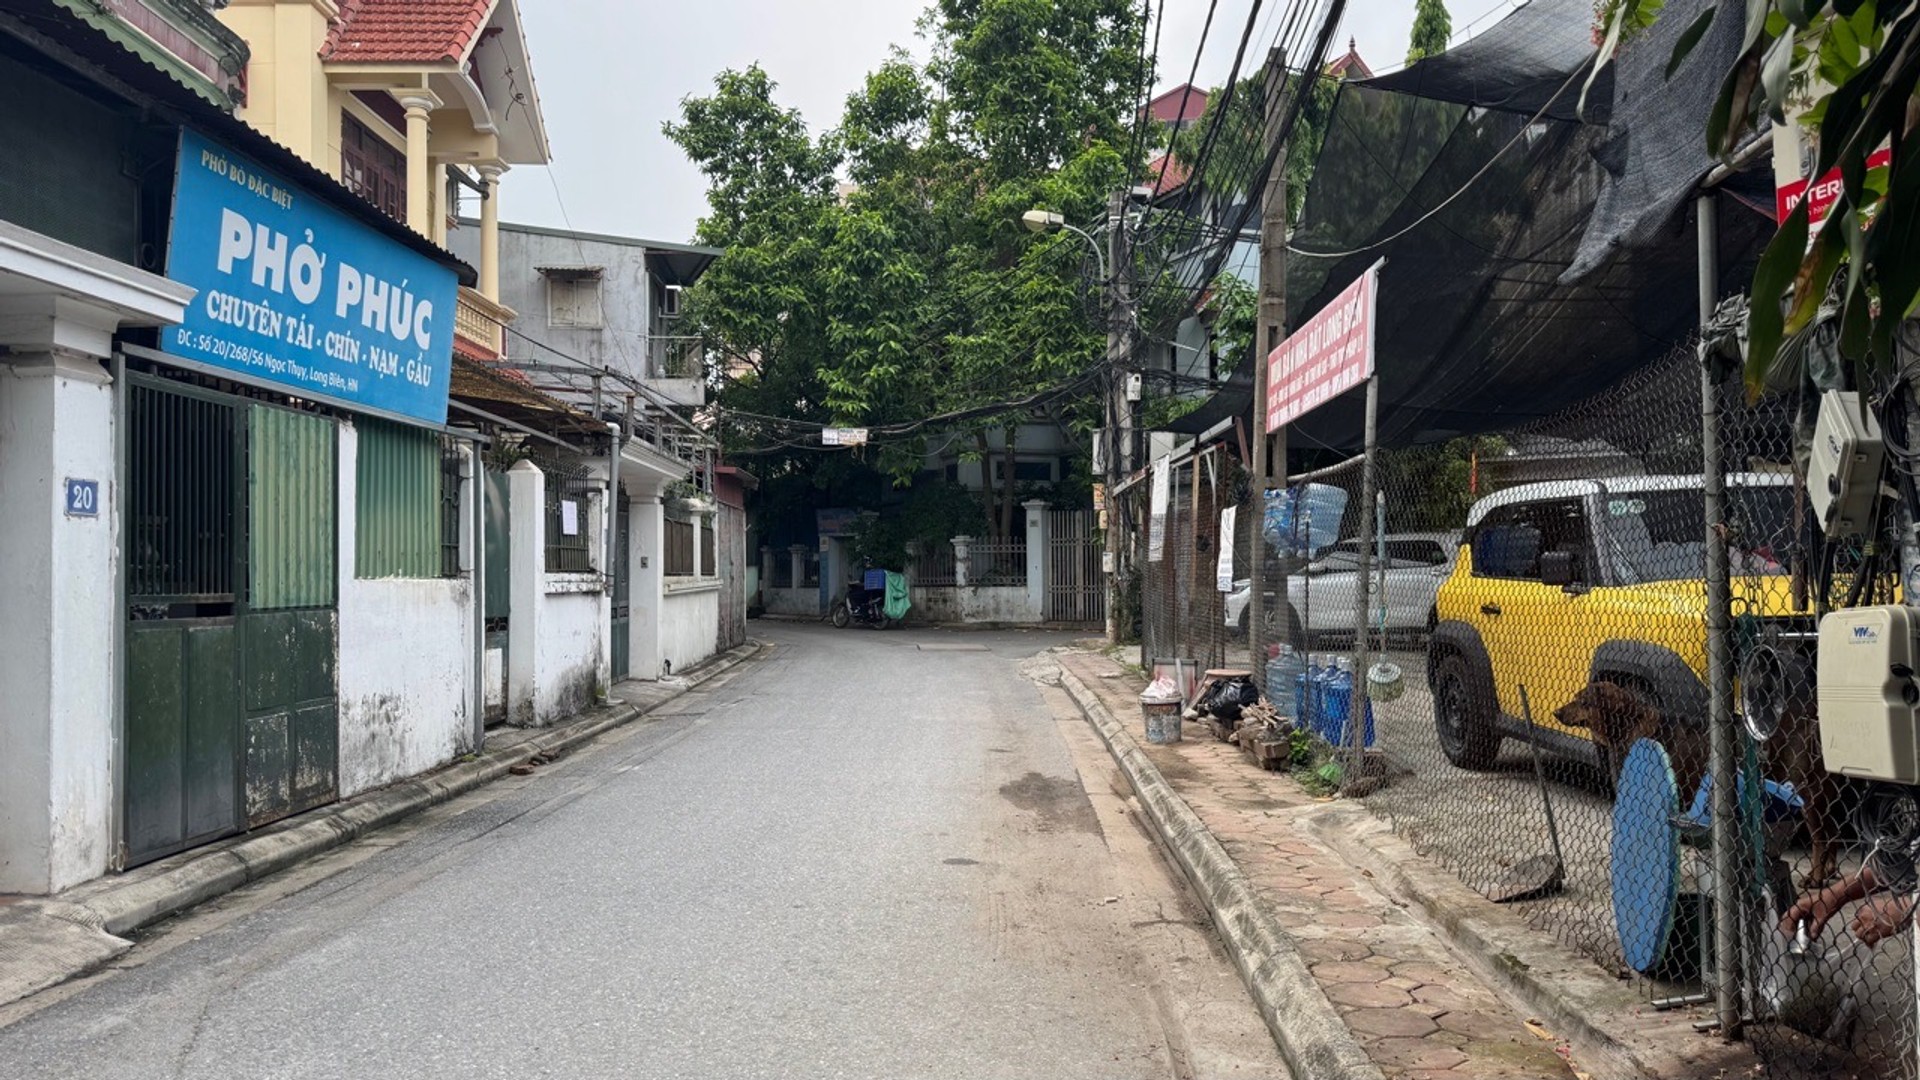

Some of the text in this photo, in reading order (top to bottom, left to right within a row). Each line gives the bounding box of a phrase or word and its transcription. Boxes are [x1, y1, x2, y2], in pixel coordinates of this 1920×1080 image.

[201, 149, 293, 210] PHỞ BÒ ĐẶC BIỆT
[217, 207, 433, 350] PHỞ PHÚC
[198, 334, 212, 351] Số
[212, 339, 264, 366] 20/268/56
[264, 352, 286, 374] Ngọc
[310, 366, 328, 387] Long
[206, 289, 283, 339] CHUYÊN
[286, 313, 314, 349] TÁI
[325, 330, 360, 364] CHÍN
[369, 345, 398, 379] NẠM
[73, 485, 92, 509] 20
